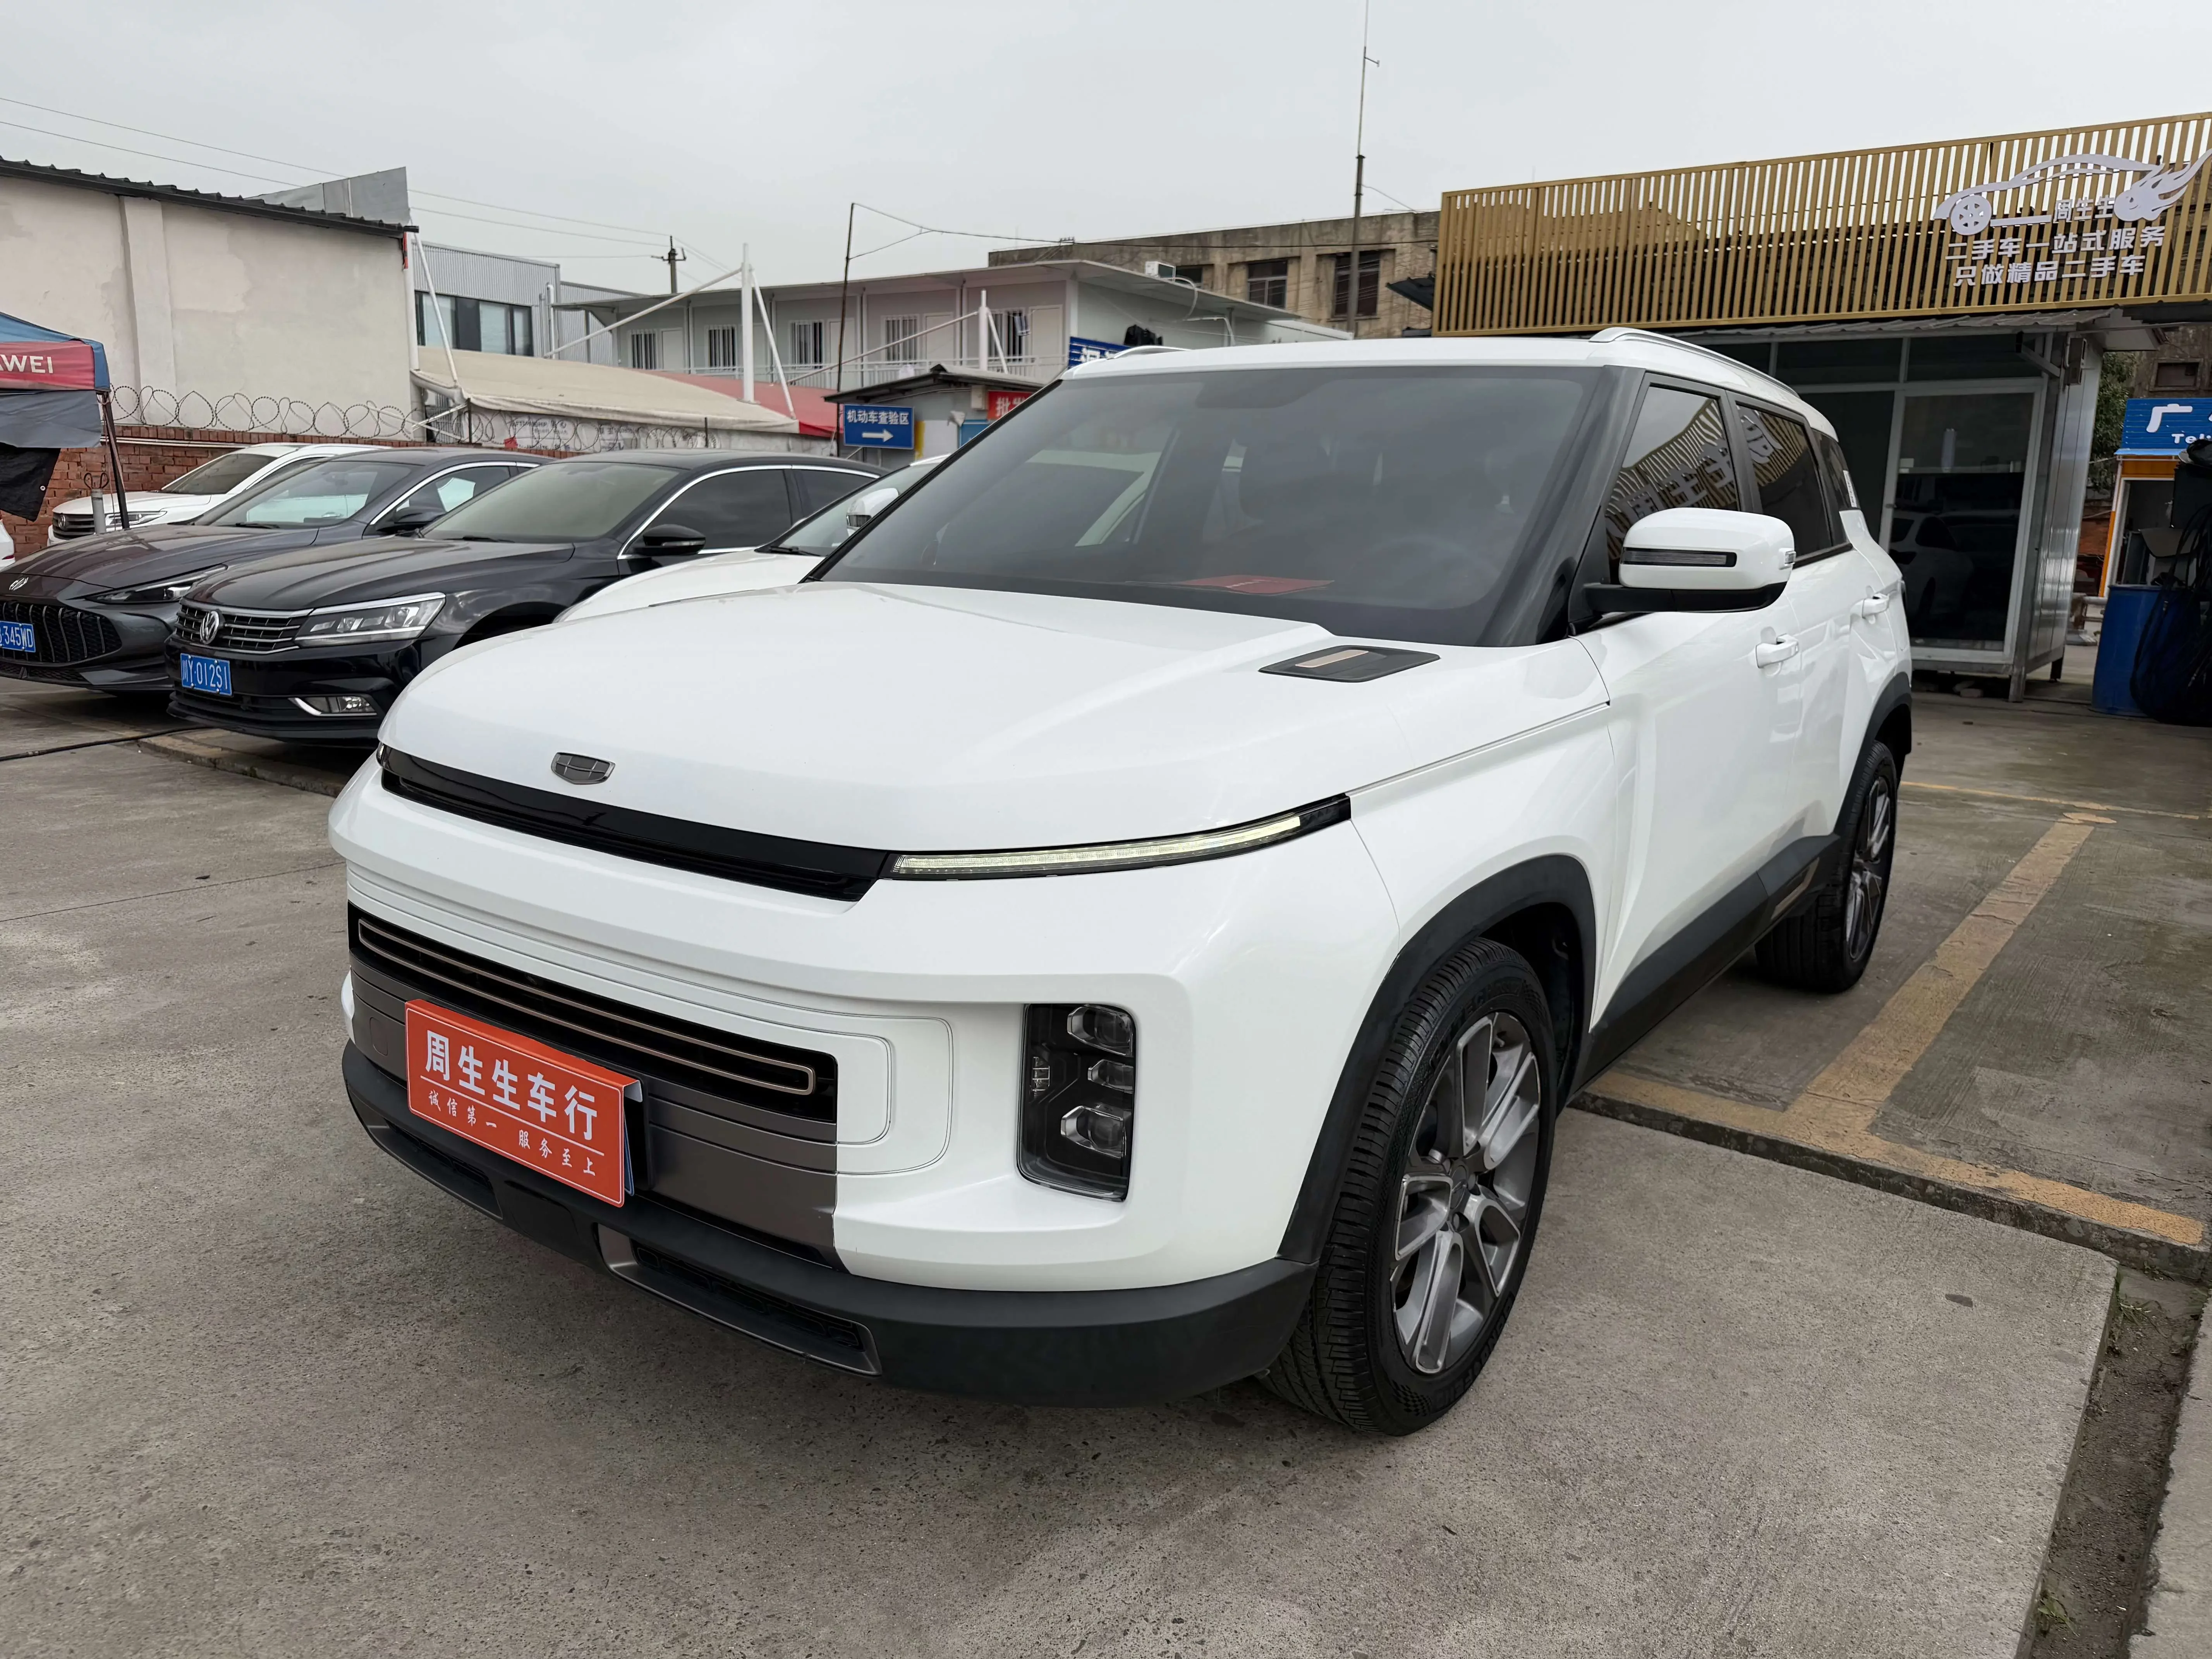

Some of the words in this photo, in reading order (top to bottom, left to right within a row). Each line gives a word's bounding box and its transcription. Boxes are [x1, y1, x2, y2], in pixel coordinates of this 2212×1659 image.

[2053, 195, 2115, 223] 周生生
[1945, 225, 2166, 260] 二手车一站式服务
[1953, 254, 2146, 287] 只做精品二手车
[0, 354, 53, 373] WEI
[847, 409, 909, 425] 机动车查验区
[2146, 404, 2212, 433] 广
[425, 1029, 598, 1140] 周生生车行
[428, 1089, 497, 1128] 诚信第一
[518, 1129, 596, 1176] 服务至上
